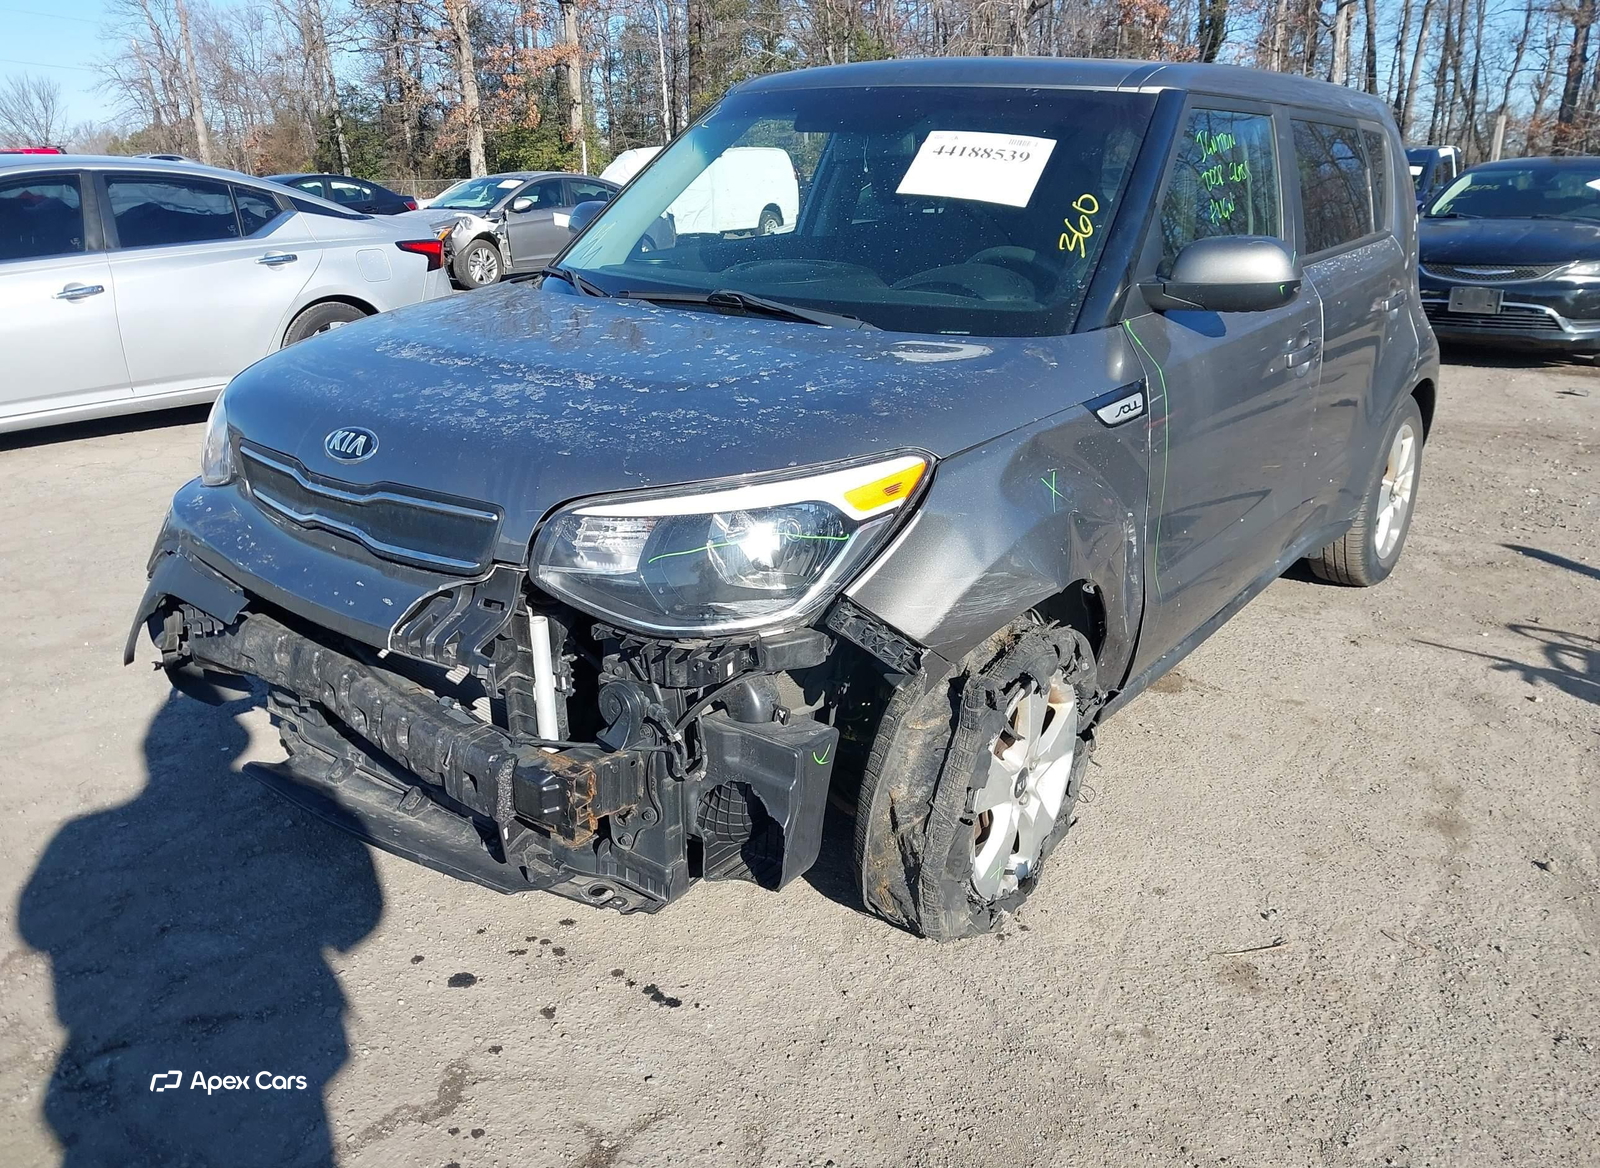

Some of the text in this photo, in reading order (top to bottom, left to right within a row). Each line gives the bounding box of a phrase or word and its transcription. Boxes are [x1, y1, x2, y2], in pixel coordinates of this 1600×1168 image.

[932, 144, 1031, 163] 44188539
[1058, 193, 1099, 259] 360
[329, 430, 367, 457] KIA
